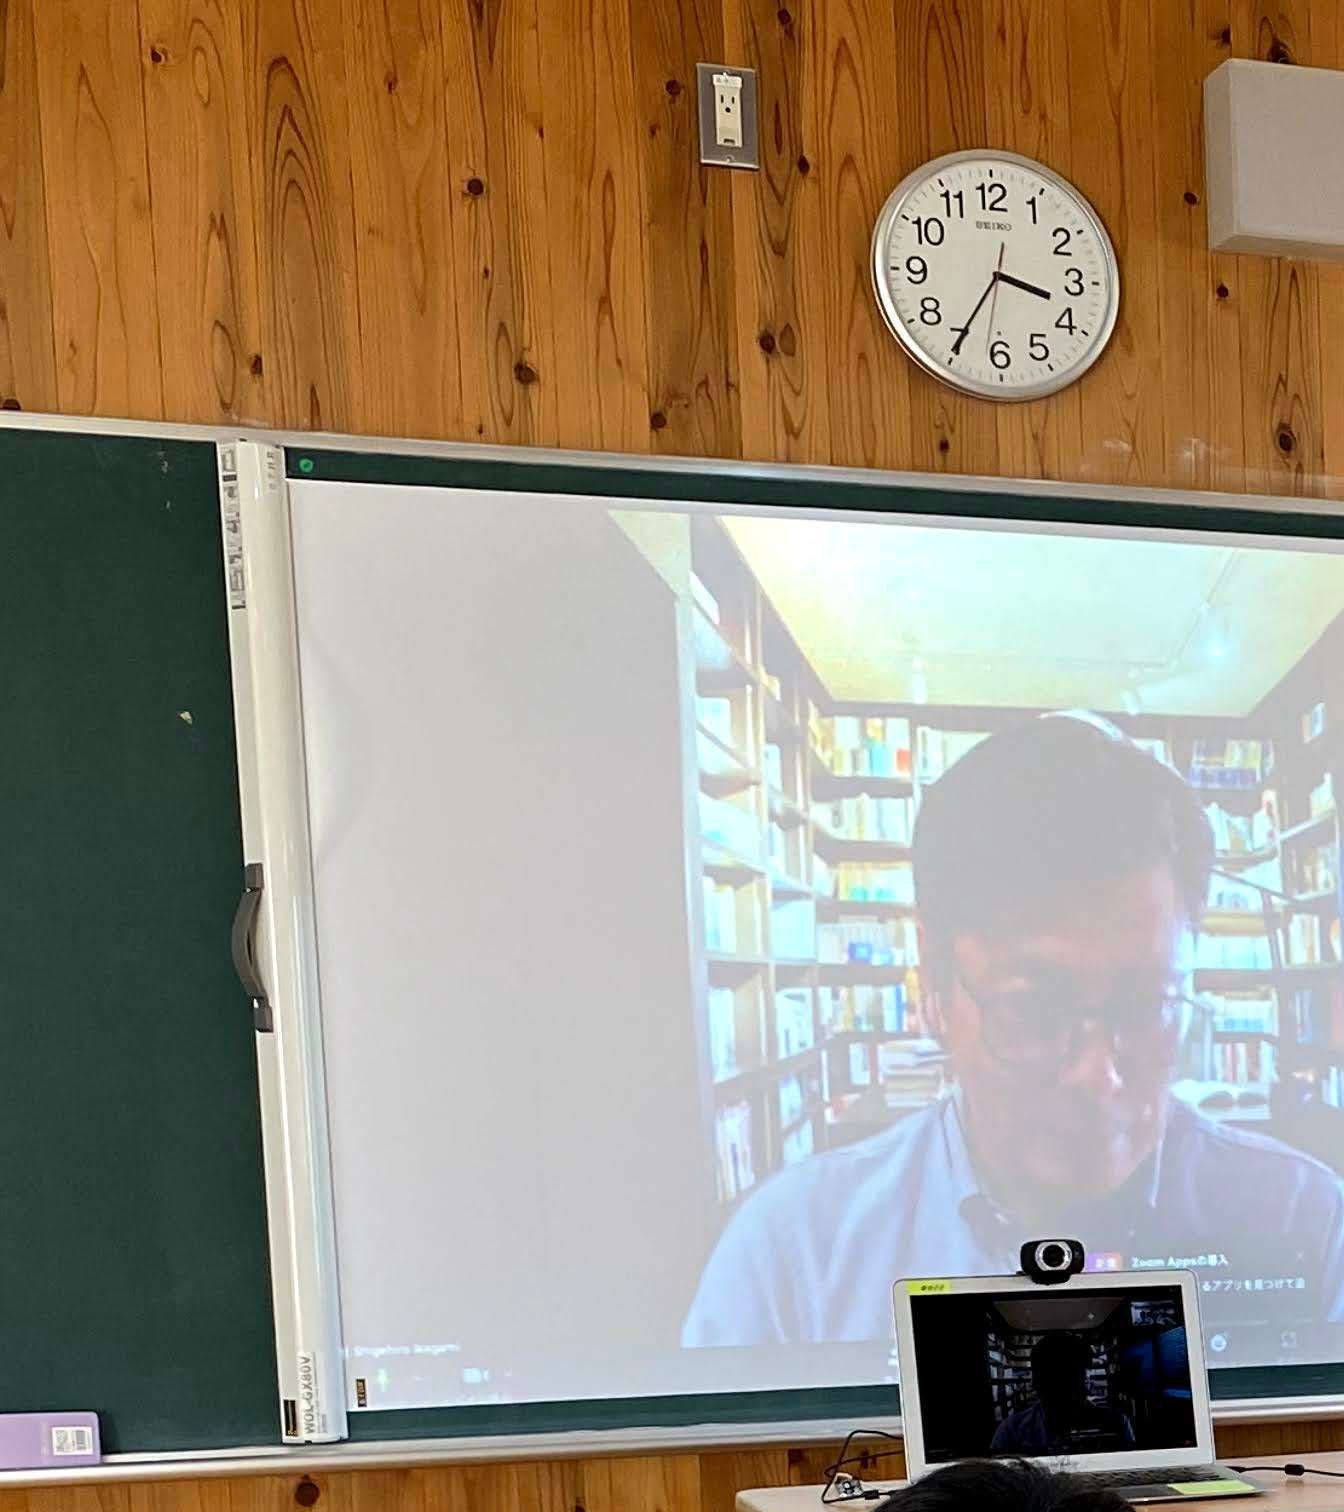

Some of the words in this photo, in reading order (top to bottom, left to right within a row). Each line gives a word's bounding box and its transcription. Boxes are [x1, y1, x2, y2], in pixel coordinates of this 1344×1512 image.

[940, 190, 965, 218] 11
[975, 183, 1008, 212] 12
[1026, 197, 1038, 225] 1
[912, 217, 945, 246] 10
[975, 220, 1013, 232] SEIKO
[1051, 227, 1073, 256] 2
[905, 256, 928, 284] 9
[1064, 267, 1084, 297] 3
[919, 297, 942, 326] 8
[1054, 307, 1077, 336] 4
[989, 341, 1011, 370] 6
[1028, 333, 1050, 361] 5
[1131, 1256, 1165, 1268] Zoom
